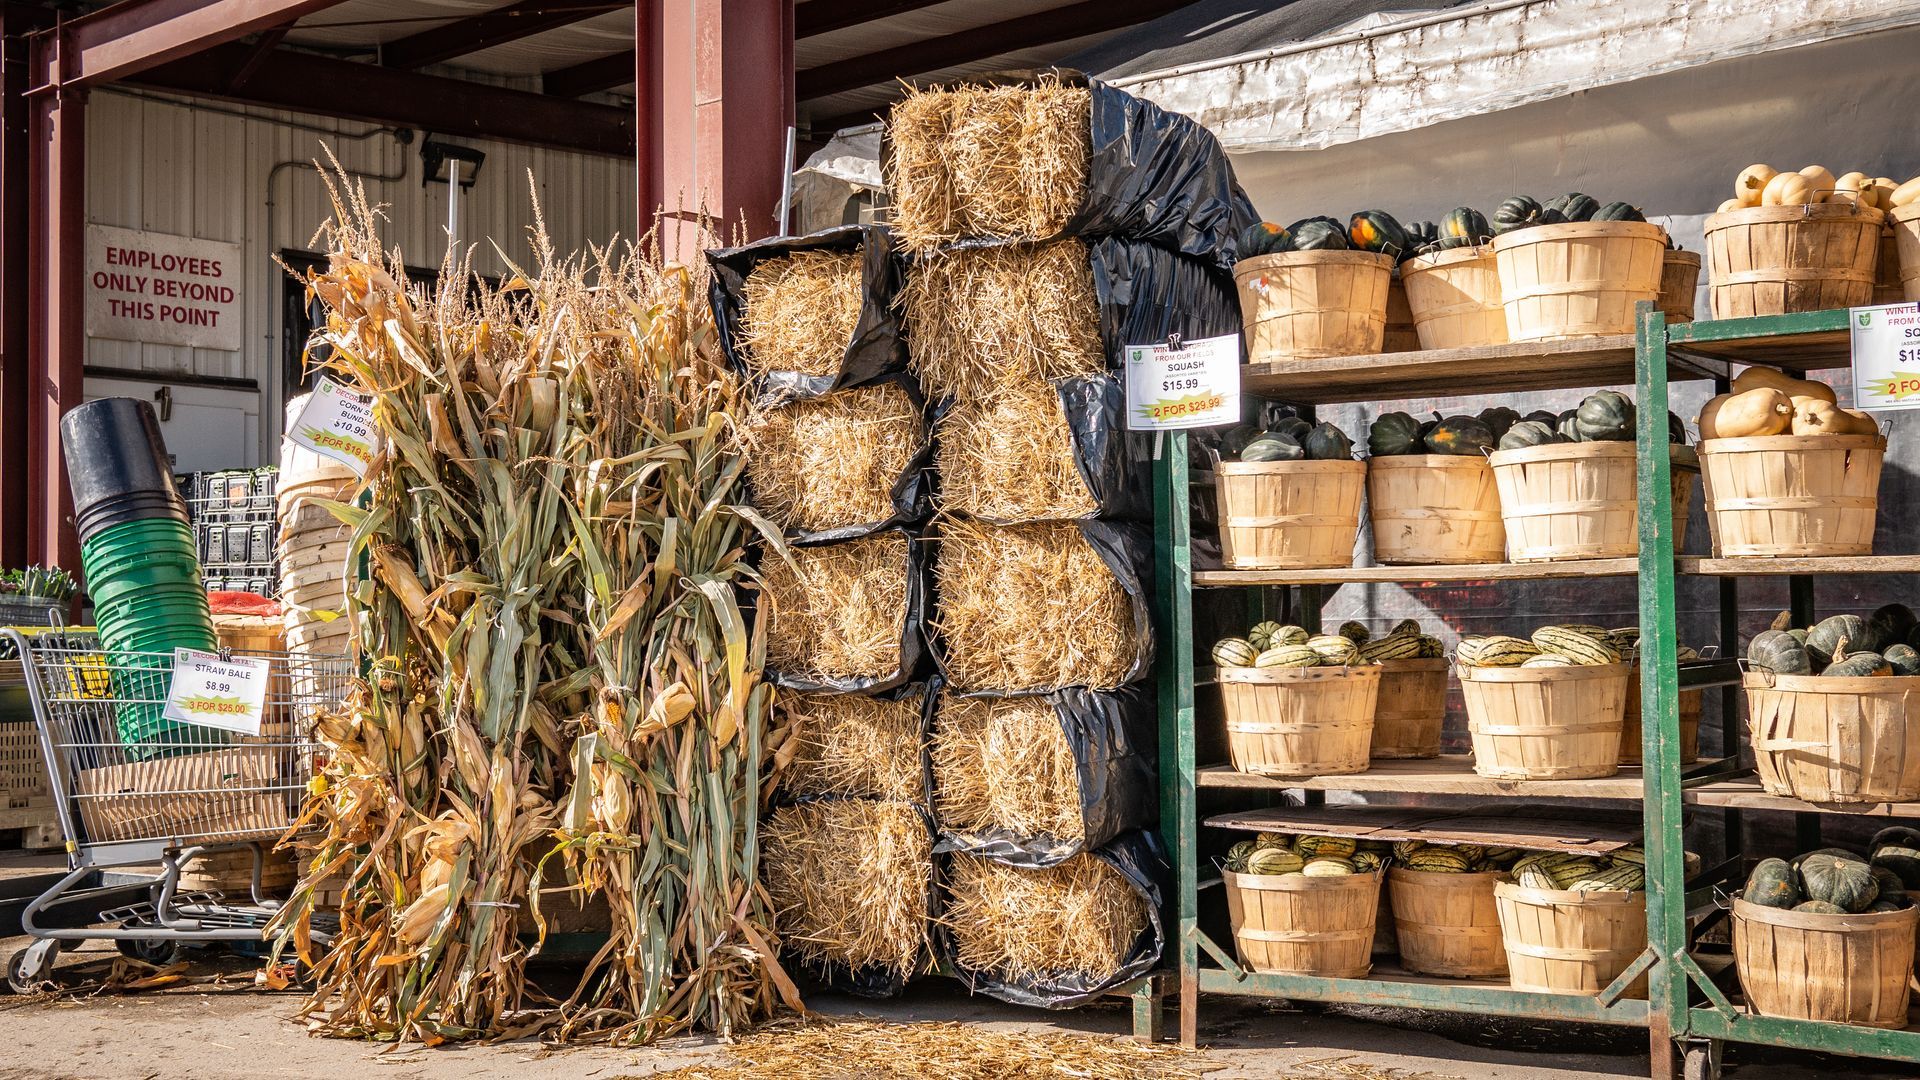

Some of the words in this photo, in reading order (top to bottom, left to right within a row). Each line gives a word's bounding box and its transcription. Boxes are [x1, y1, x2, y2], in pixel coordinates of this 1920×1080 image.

[106, 246, 222, 278] EMPLOYEES
[93, 271, 148, 294] ONLY
[153, 278, 235, 304] BEYOND
[107, 298, 155, 321] THIS
[160, 304, 221, 328] POINT
[1888, 317, 1915, 326] FROM
[1154, 354, 1176, 362] FROM
[1176, 352, 1191, 361] OUR
[1193, 349, 1215, 358] FIELDS
[1167, 360, 1205, 372] SQUASH
[1162, 378, 1199, 392] $15.99
[1888, 382, 1897, 395] 2
[339, 399, 364, 414] CORN
[1154, 407, 1161, 418] 2
[1163, 403, 1187, 417] FOR
[1188, 397, 1220, 413] $29.99
[333, 418, 367, 437] $10.99
[313, 433, 321, 442] 2
[322, 436, 344, 449] FOR
[344, 442, 371, 464] $19.99
[195, 663, 227, 676] STRAW
[227, 669, 252, 680] BALE
[205, 680, 230, 693] $8.99
[189, 701, 195, 710] 3
[196, 701, 216, 712] FOR
[217, 702, 246, 714] $25.00
